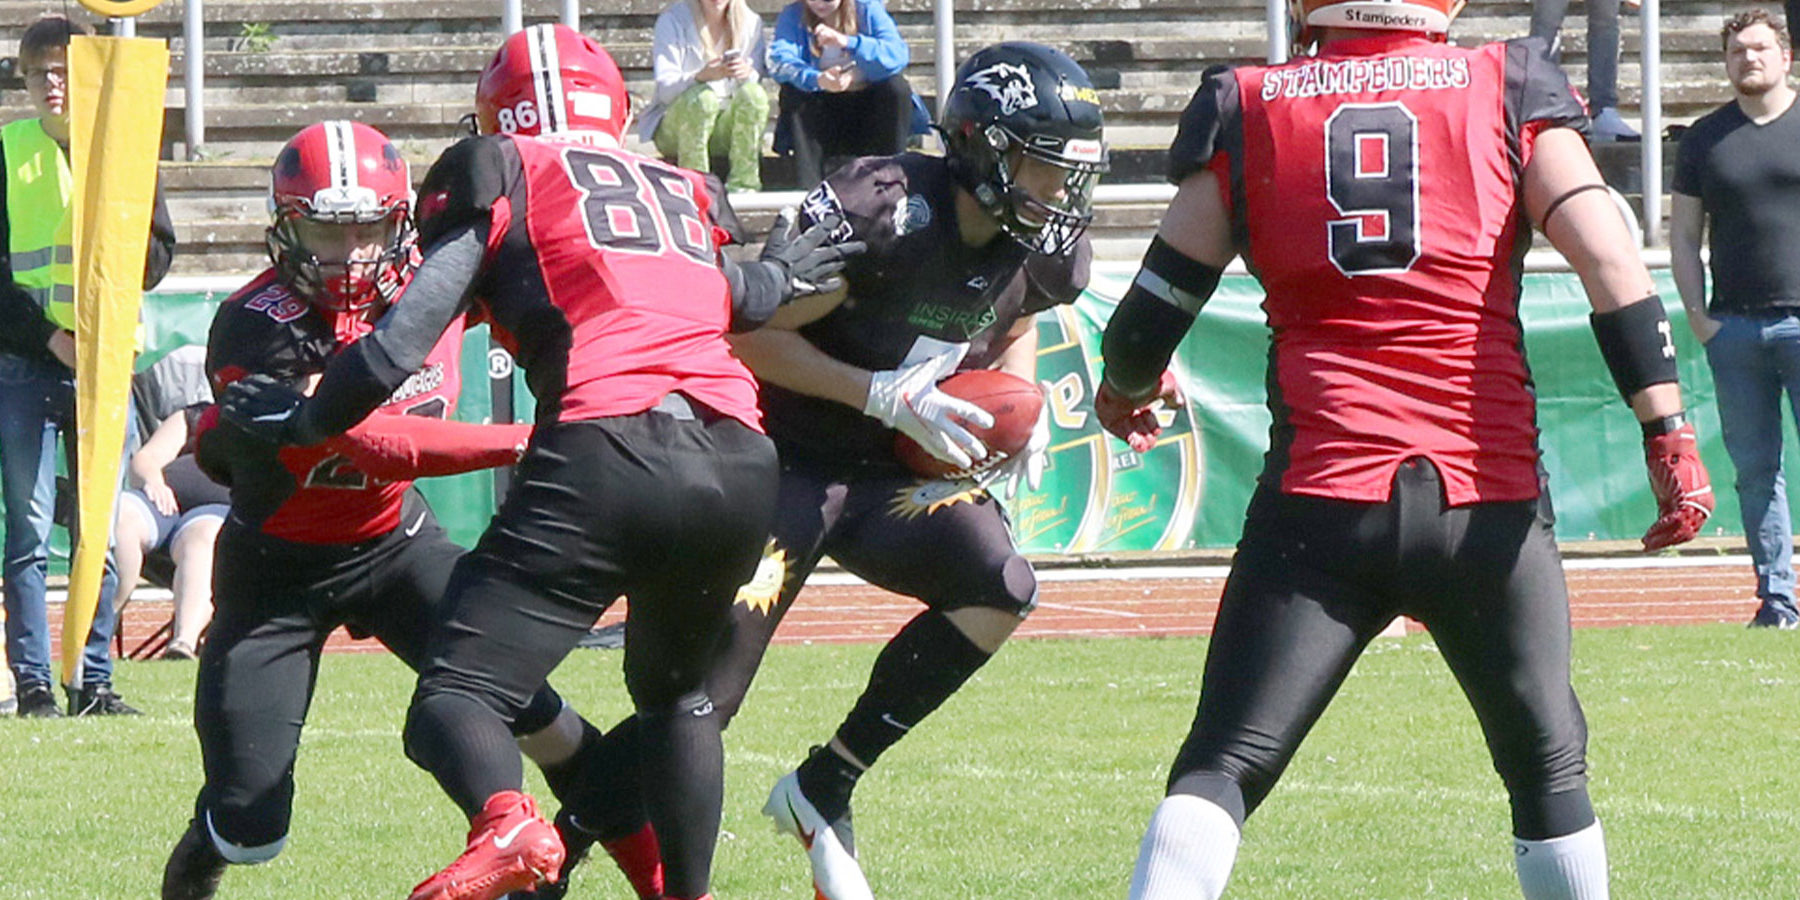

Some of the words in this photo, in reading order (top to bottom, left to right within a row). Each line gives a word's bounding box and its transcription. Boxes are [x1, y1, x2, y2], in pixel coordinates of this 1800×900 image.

[1345, 9, 1426, 26] Stampeders
[1262, 57, 1470, 101] STAMPEDERS
[498, 101, 538, 133] 86
[560, 147, 718, 269] 86
[1324, 101, 1421, 277] 9
[244, 284, 309, 323] 29
